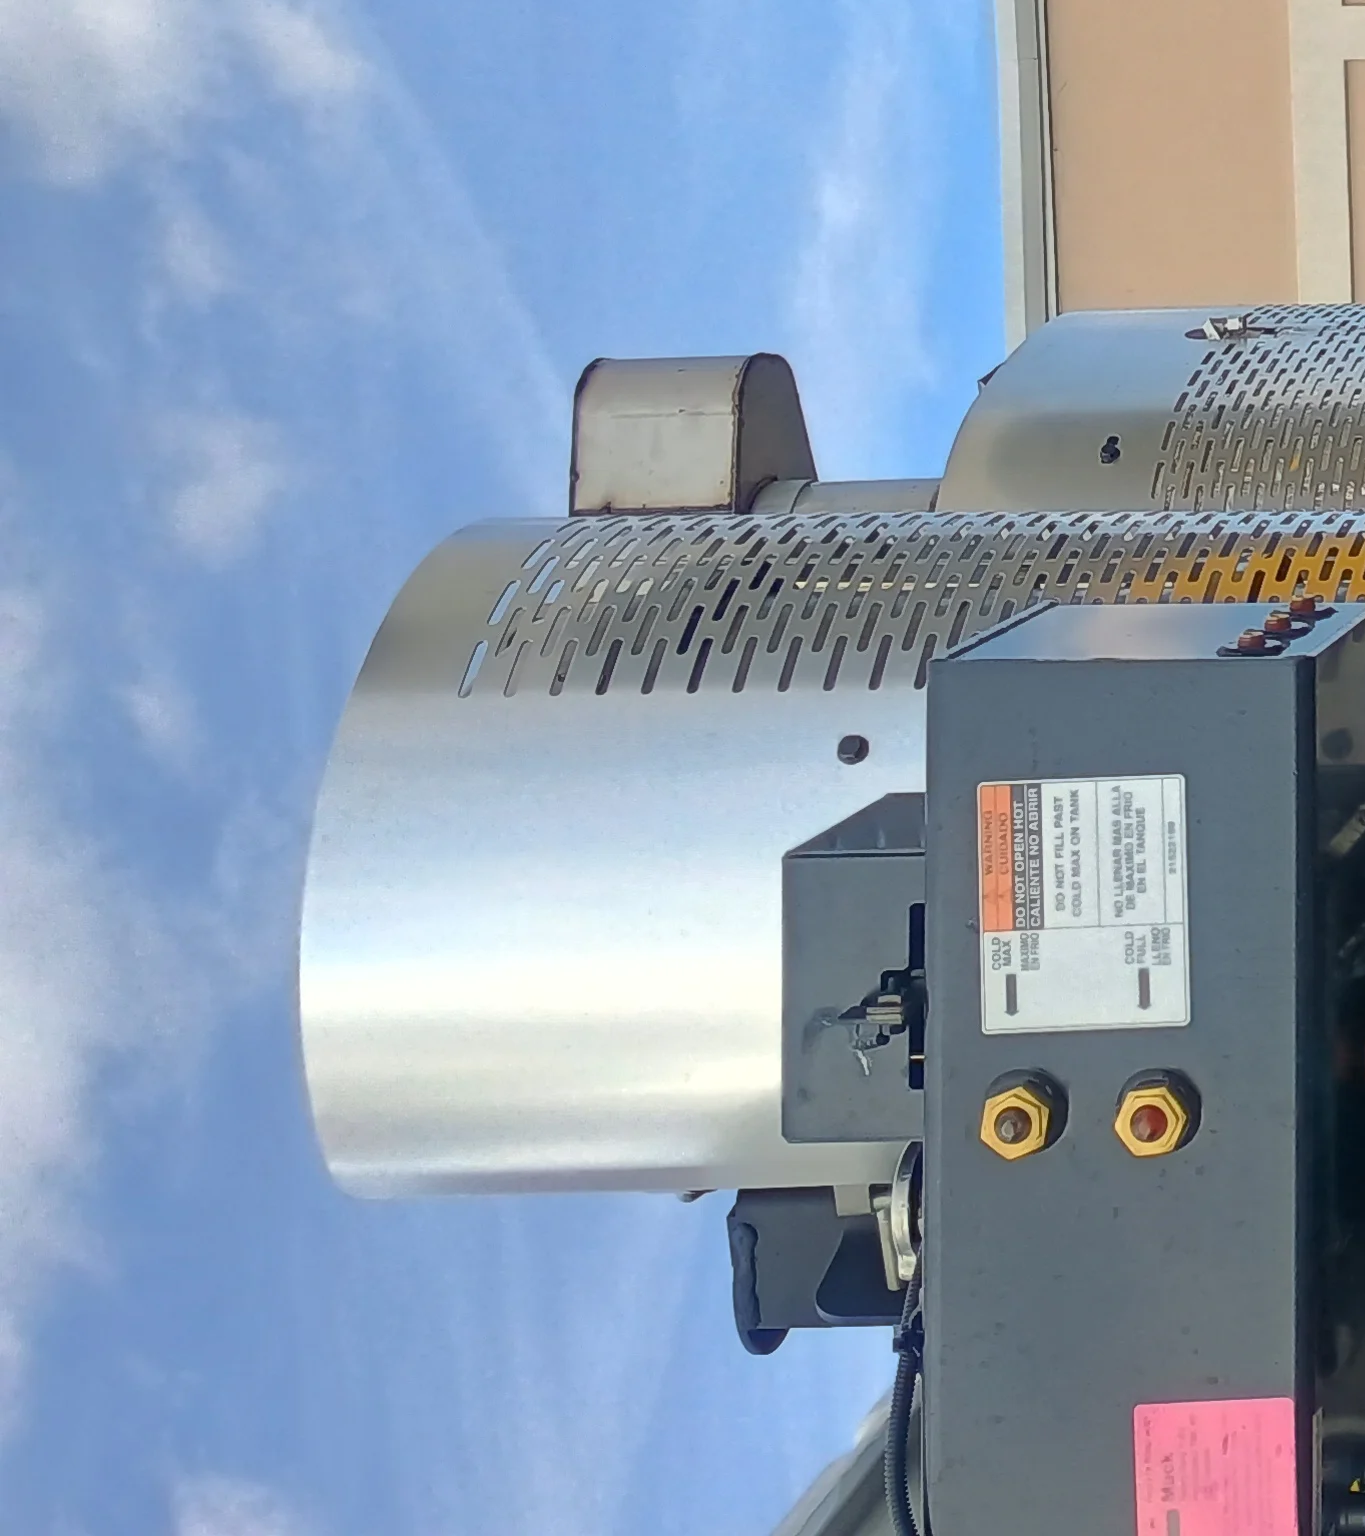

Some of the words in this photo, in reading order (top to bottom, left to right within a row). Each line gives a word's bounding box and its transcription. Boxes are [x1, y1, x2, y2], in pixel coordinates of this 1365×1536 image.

[1013, 800, 1024, 829] HOT
[1027, 788, 1039, 831] ABRIR
[1053, 796, 1064, 828] PAST
[1069, 789, 1080, 823] TANK
[1111, 785, 1121, 816] ALLA
[1123, 792, 1133, 819] FRIO
[983, 811, 993, 875] WARNING
[998, 812, 1009, 875] CUIDADO
[1028, 835, 1040, 855] NO
[1070, 827, 1080, 846] ON
[1112, 820, 1122, 846] MAS
[1124, 823, 1134, 838] EN
[1135, 807, 1146, 854] TANQUE
[1013, 833, 1025, 872] OPEN
[1054, 832, 1064, 859] FILL
[1054, 864, 1065, 889] NOT
[1070, 850, 1081, 877] MAX
[1112, 849, 1123, 896] LLENAR
[1124, 842, 1135, 890] MAXIMO
[1136, 859, 1146, 873] EL
[1014, 875, 1025, 904] NOT
[1029, 859, 1041, 927] CALIENTE
[1071, 881, 1082, 917] COLD
[1137, 877, 1147, 893] EN
[1055, 893, 1065, 911] DO
[1114, 900, 1123, 918] NO
[1126, 895, 1135, 910] DE
[1015, 907, 1026, 927] DO
[991, 937, 1001, 970] COLD
[1002, 940, 1011, 967] MAX
[1020, 933, 1030, 971] MAXIMO
[1030, 933, 1040, 956] FRIO
[1124, 931, 1135, 965] COLD
[1135, 935, 1146, 964] FULL
[1151, 927, 1161, 965] LLENO
